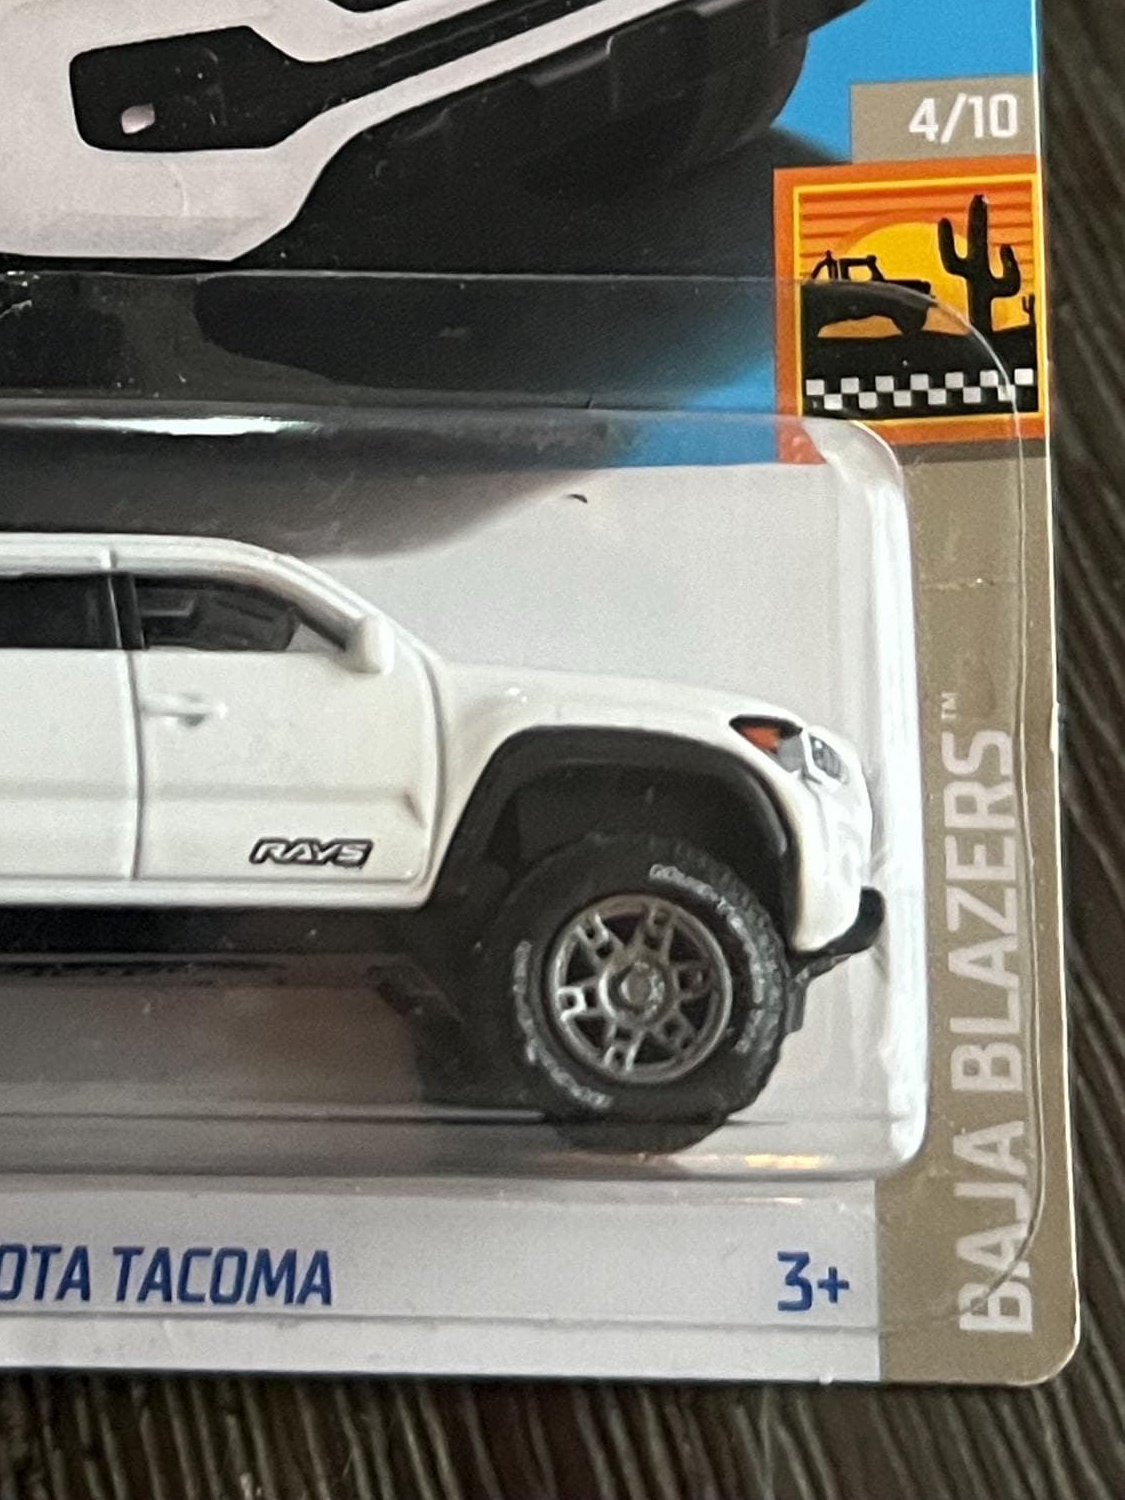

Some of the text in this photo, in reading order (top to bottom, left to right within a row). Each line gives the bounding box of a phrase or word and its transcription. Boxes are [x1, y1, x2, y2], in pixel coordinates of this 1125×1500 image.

[908, 93, 1019, 144] 4/10
[248, 836, 374, 869] RAYS
[953, 1120, 1033, 1333] BAJA
[112, 1246, 332, 1306] TACOMA
[777, 1250, 850, 1312] 3+
